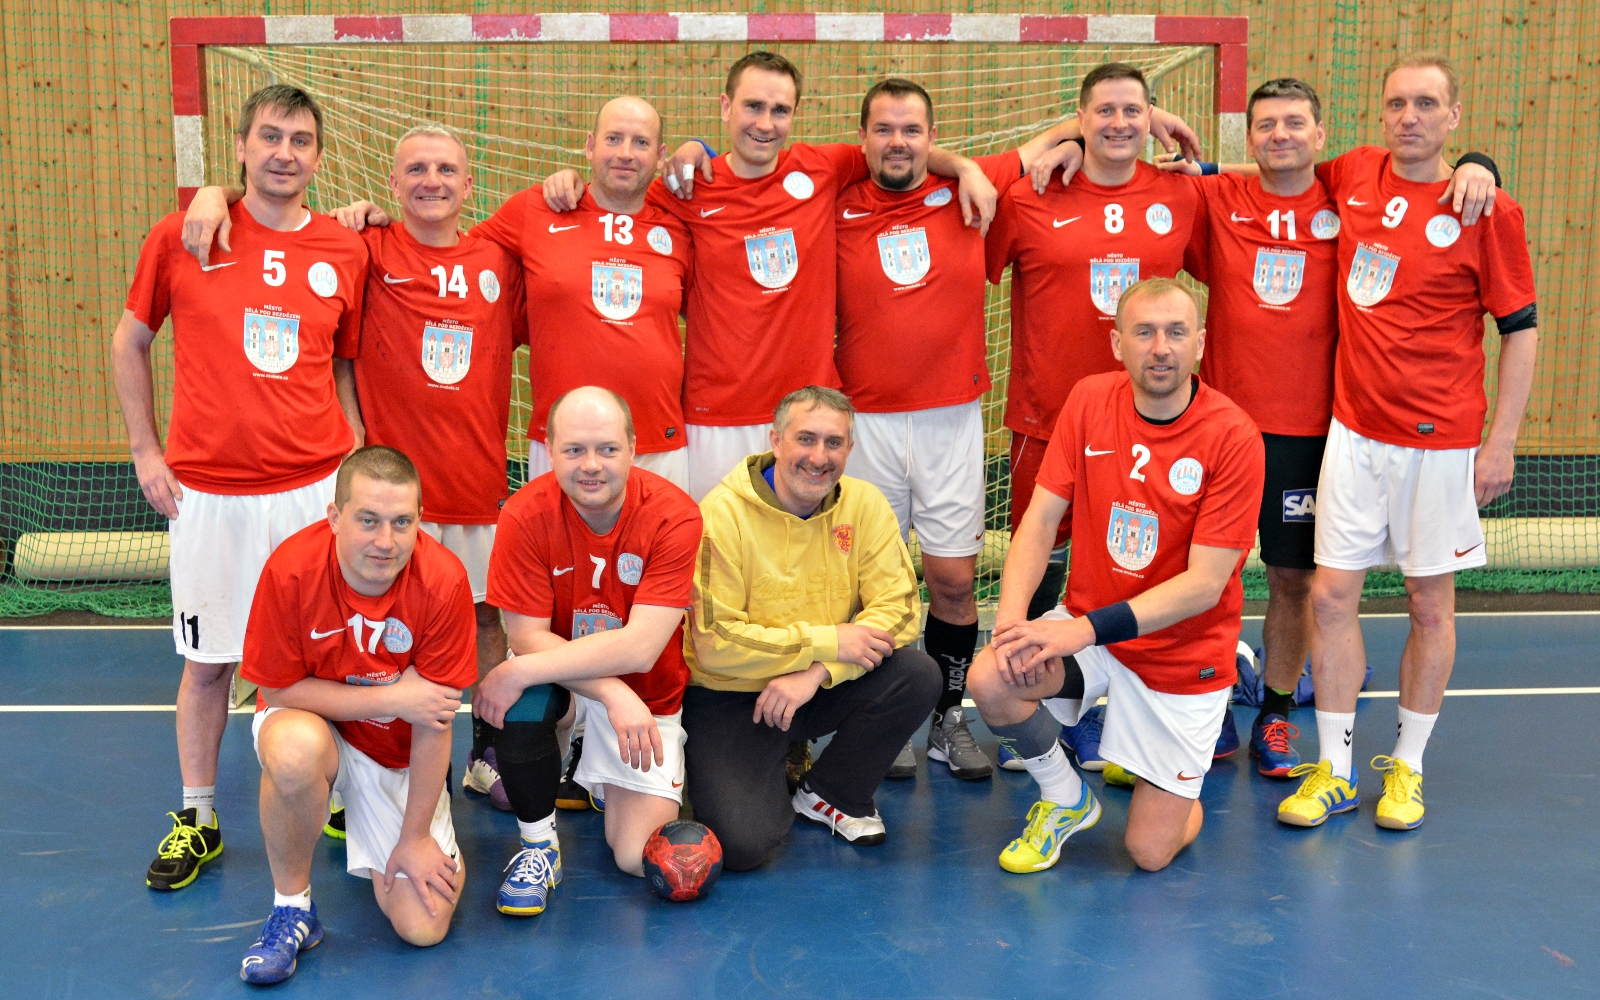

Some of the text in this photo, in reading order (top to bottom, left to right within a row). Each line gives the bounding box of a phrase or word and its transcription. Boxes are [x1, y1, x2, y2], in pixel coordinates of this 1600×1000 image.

[598, 213, 634, 245] 13
[1103, 203, 1125, 234] 8
[1266, 209, 1297, 240] 11
[1381, 196, 1409, 229] 9
[262, 249, 287, 287] 5
[430, 264, 469, 298] 14
[1129, 443, 1151, 483] 2
[1128, 500, 1147, 508] MĚSTO
[589, 553, 607, 589] 7
[180, 611, 200, 650] 11
[347, 612, 386, 655] 17
[366, 670, 387, 678] MĚSTO
